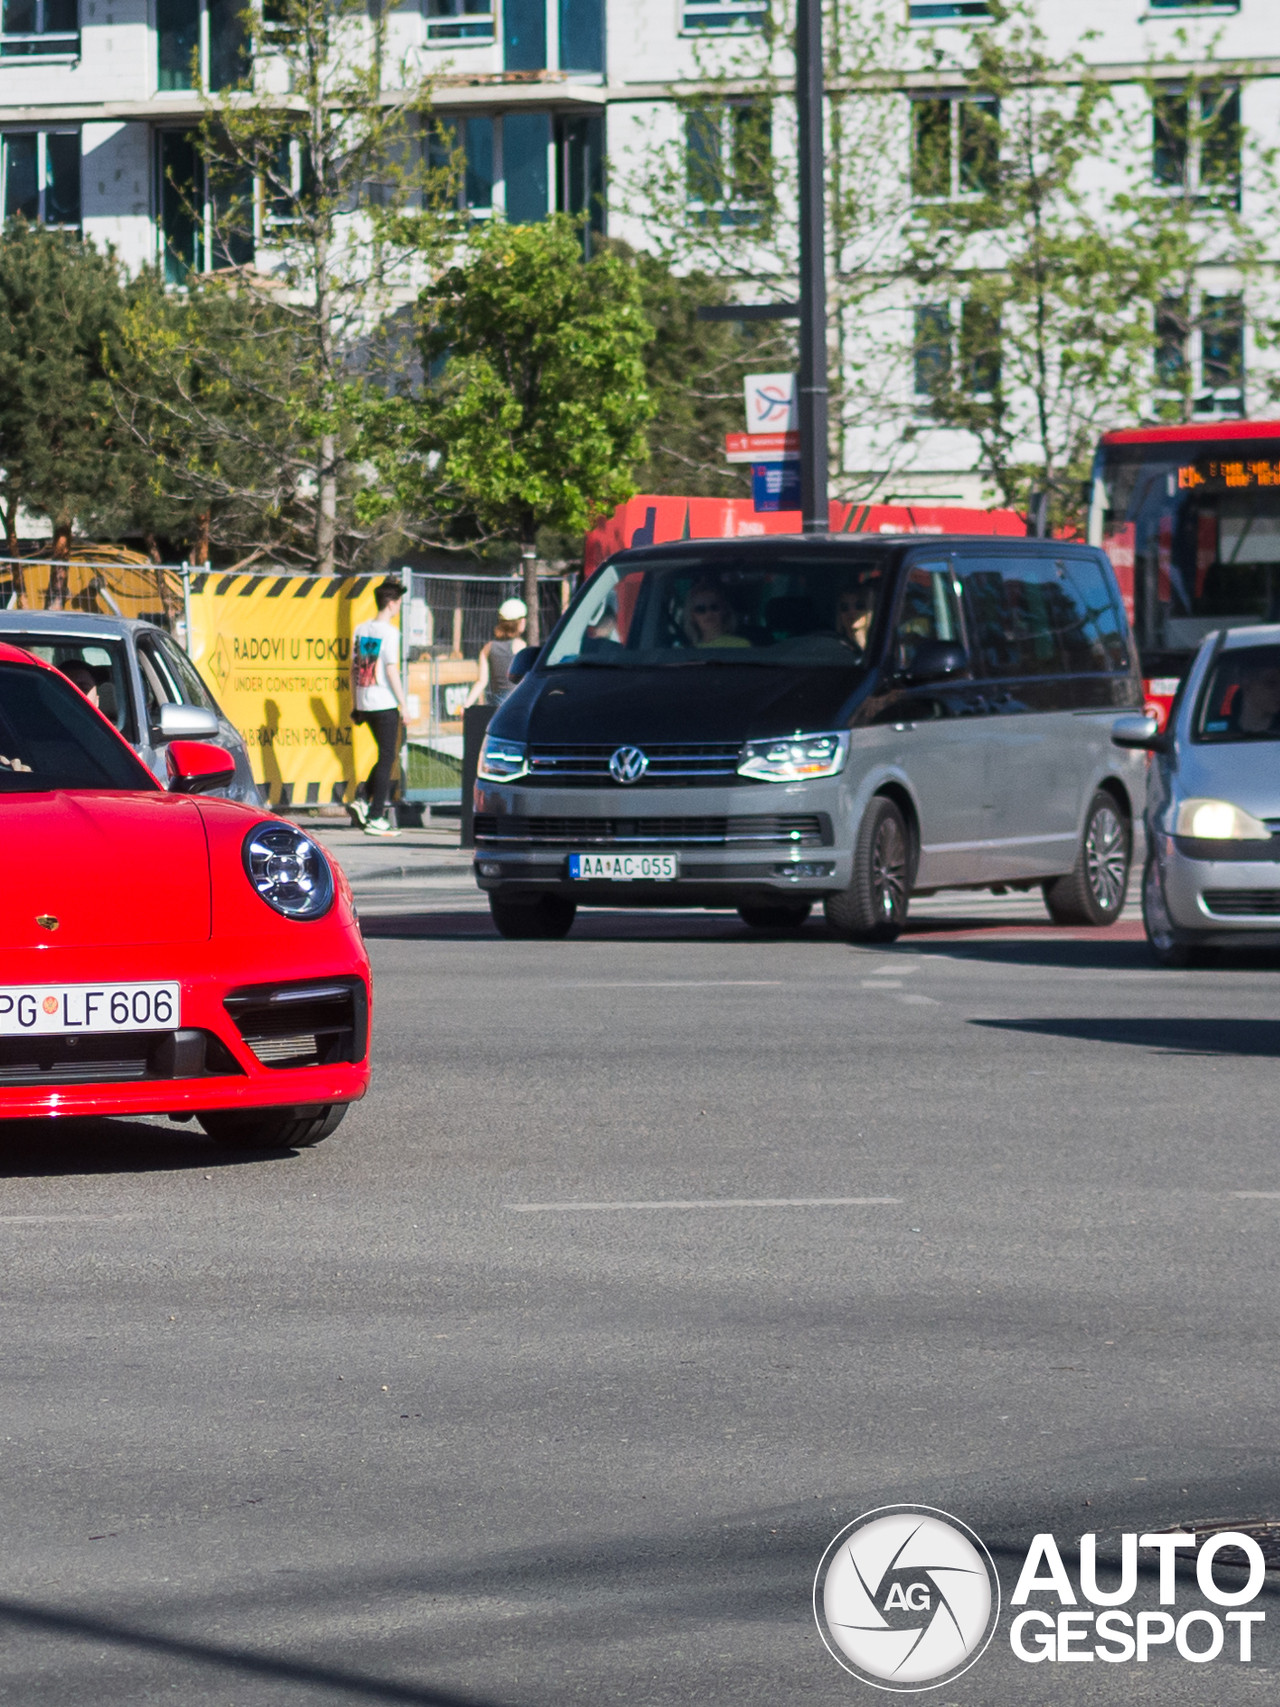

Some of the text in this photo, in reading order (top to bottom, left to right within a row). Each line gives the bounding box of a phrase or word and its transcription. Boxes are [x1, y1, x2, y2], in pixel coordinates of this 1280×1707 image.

[233, 637, 351, 661] RADOVI U TOKU
[233, 676, 351, 693] UNDER CONSTRUCTION
[239, 726, 352, 747] ABRANJEN PROLAZ
[583, 857, 604, 876] AA
